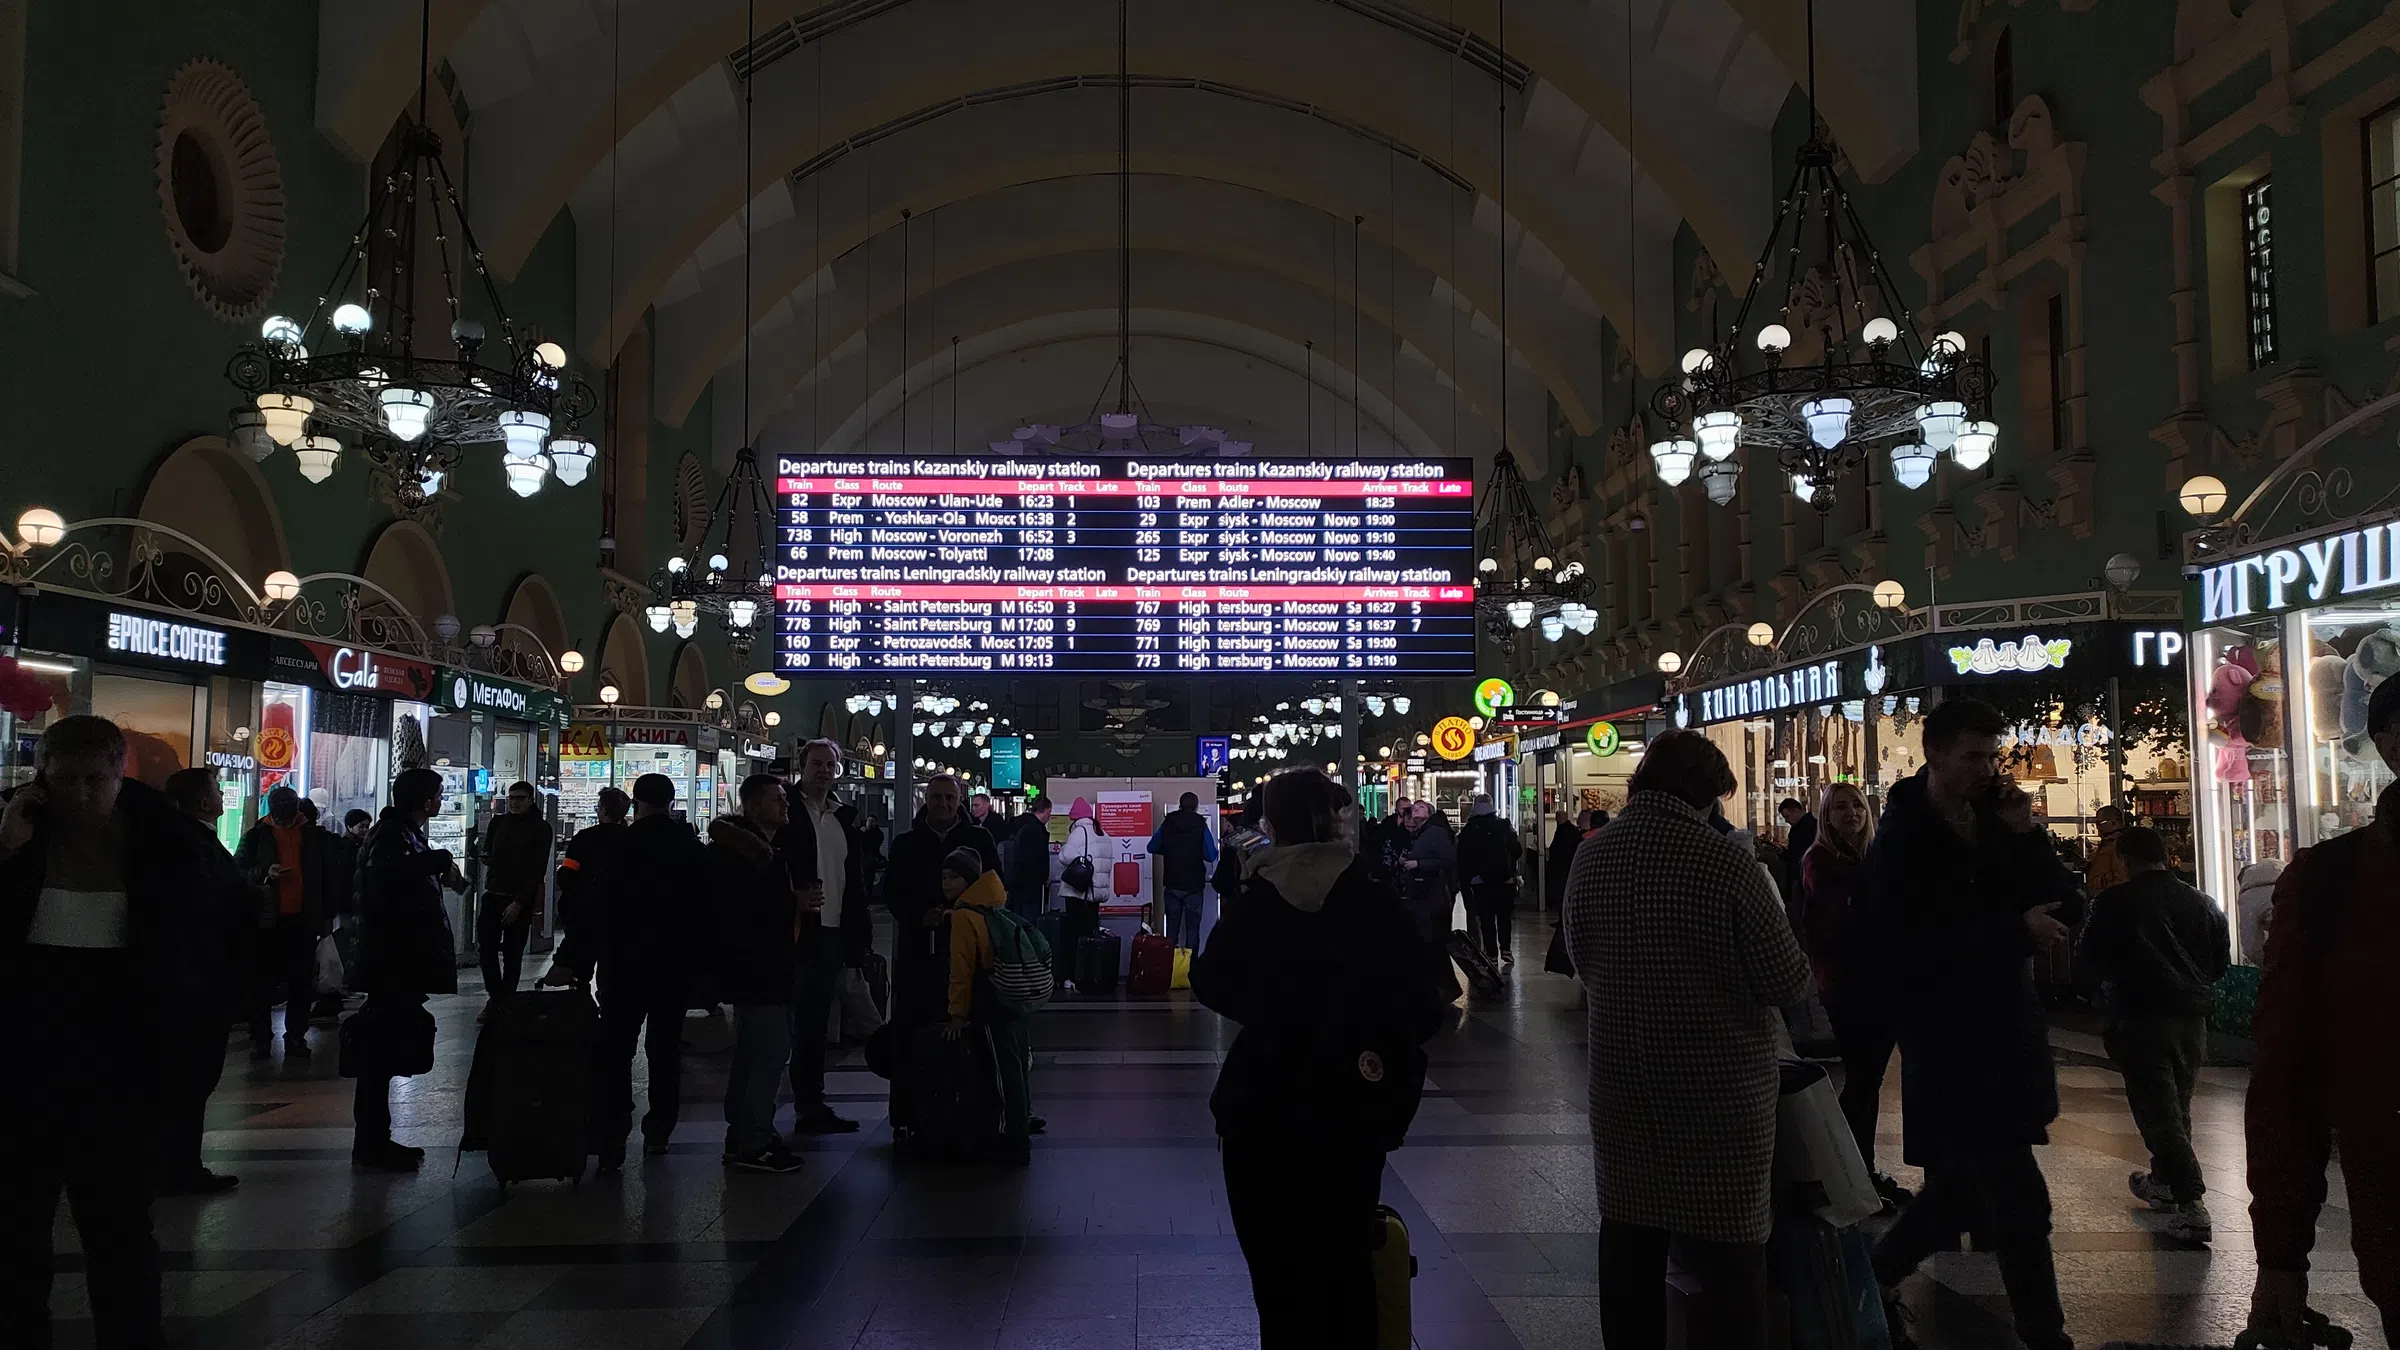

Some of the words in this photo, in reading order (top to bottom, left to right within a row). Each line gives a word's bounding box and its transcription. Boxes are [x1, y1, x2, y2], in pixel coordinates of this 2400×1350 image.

[779, 459, 866, 478] Departures
[866, 460, 911, 475] trains
[913, 460, 990, 478] Kazanskiy
[991, 460, 1046, 479] railway
[1047, 461, 1101, 476] station
[1127, 462, 1212, 480] Departures
[1212, 462, 1257, 477] trains
[1258, 462, 1334, 480] Kazanskiy
[1334, 461, 1390, 480] railway
[1390, 463, 1444, 477] station
[786, 478, 813, 489] Train
[833, 478, 860, 489] Class
[872, 478, 903, 490] Route
[1018, 480, 1055, 493] Depart
[1057, 480, 1086, 491] Track
[1095, 481, 1119, 492] Late
[1135, 481, 1161, 491] Train
[1181, 481, 1207, 492] Class
[1218, 481, 1249, 492] Route
[1362, 482, 1398, 492] Arrives
[1401, 481, 1429, 492] Track
[1439, 482, 1462, 492] Late
[791, 493, 809, 506] 82
[831, 494, 863, 509] Expr
[871, 494, 928, 507] Moscow
[939, 494, 1004, 507] Ulan-Ude
[1018, 493, 1054, 508] 16:23
[1068, 494, 1075, 508] 1
[1136, 496, 1161, 508] 103
[1176, 496, 1212, 508] Prem
[1217, 495, 1256, 508] Adler
[1265, 496, 1322, 509] Moscow
[1365, 497, 1395, 508] 18:25
[791, 511, 809, 524] 58
[829, 511, 864, 524] Prem
[884, 510, 969, 525] Yoshkar-Ola
[1018, 513, 1055, 525] 16:38
[1066, 510, 1078, 526] 2
[1139, 513, 1157, 526] 29
[1179, 513, 1210, 528] Expr
[1217, 512, 1250, 528] siysk
[1260, 514, 1316, 526] Moscow
[1323, 514, 1361, 527] Novo
[1365, 515, 1396, 525] 19:00
[786, 529, 813, 541] 738
[830, 528, 863, 544] High
[871, 529, 928, 542] Moscow
[937, 528, 1003, 543] Voronezh
[1018, 528, 1056, 543] 16:52
[1064, 527, 1076, 543] 3
[1135, 531, 1161, 544] 265
[1179, 531, 1210, 546] Expr
[1218, 530, 1250, 546] siysk
[1260, 531, 1316, 544] Moscow
[1323, 531, 1361, 544] Novo
[1366, 532, 1396, 543] 19:10
[790, 547, 808, 560] 66
[828, 547, 864, 560] Prem
[871, 547, 928, 560] Moscow
[937, 546, 988, 562] Tolyatti
[1017, 546, 1055, 561] 17:08
[1136, 549, 1161, 561] 125
[1179, 549, 1210, 564] Expr
[1218, 548, 1251, 564] siysk
[1260, 549, 1316, 561] Moscow
[1323, 549, 1361, 561] Novo
[1365, 550, 1396, 561] 19:40
[777, 566, 858, 582] Departures
[859, 566, 901, 580] trains
[903, 566, 1002, 583] Leningradskiy
[1003, 566, 1055, 583] railway
[1056, 567, 1107, 581] station
[1127, 568, 1207, 584] Departures
[1207, 567, 1249, 581] trains
[1250, 567, 1348, 584] Leningradskiy
[1348, 567, 1400, 584] railway
[1400, 568, 1451, 582] station
[785, 585, 812, 596] Train
[832, 585, 859, 596] Class
[870, 585, 902, 596] Route
[1017, 586, 1054, 599] Depart
[1057, 586, 1085, 597] Track
[1095, 587, 1118, 597] Late
[1134, 586, 1161, 597] Train
[1181, 586, 1207, 597] Class
[1218, 587, 1250, 597] Route
[1363, 587, 1399, 597] Arrives
[1402, 586, 1431, 597] Track
[1439, 587, 1464, 598] Late
[785, 600, 812, 612] 776
[829, 599, 862, 615] High
[883, 600, 919, 613] Saint
[920, 599, 993, 616] Petersburg
[1017, 601, 1054, 613] 16:50
[1066, 600, 1076, 613] 3
[1135, 601, 1161, 614] 767
[1178, 601, 1211, 616] High
[1217, 601, 1273, 616] tersburg
[1282, 601, 1339, 614] Moscow
[1366, 602, 1396, 613] 16:27
[1411, 600, 1422, 614] 5
[784, 618, 811, 630] 778
[828, 617, 862, 634] High
[883, 617, 919, 631] Saint
[919, 617, 992, 634] Petersburg
[1017, 617, 1054, 631] 17:00
[1066, 618, 1076, 631] 9
[1135, 619, 1161, 632] 769
[1178, 618, 1211, 634] High
[1217, 618, 1273, 634] tersburg
[1283, 619, 1340, 632] Moscow
[1366, 620, 1397, 631] 16:37
[1411, 618, 1422, 632] 7
[108, 612, 121, 650] ONE
[119, 613, 171, 657] PRICE
[169, 623, 229, 667] COFFEE
[785, 636, 811, 648] 160
[829, 636, 861, 651] Expr
[883, 636, 973, 649] Petrozavodsk
[1017, 636, 1054, 649] 17:05
[1067, 636, 1075, 649] 1
[1135, 637, 1159, 649] 771
[1178, 636, 1211, 652] High
[1217, 636, 1273, 652] tersburg
[1283, 636, 1340, 649] Moscow
[1366, 638, 1397, 648] 19:00
[274, 656, 319, 671] АКСЕССУАРЫ
[784, 653, 811, 666] 780
[828, 653, 861, 669] High
[882, 654, 918, 666] Saint
[919, 653, 992, 669] Petersburg
[1017, 654, 1054, 667] 19:13
[1135, 654, 1161, 667] 773
[1178, 654, 1211, 670] High
[1217, 654, 1273, 670] tersburg
[1283, 654, 1340, 667] Moscow
[1366, 655, 1398, 666] 19:10
[1701, 660, 1839, 722] ХИНКАЛЬНАЯ
[1438, 718, 1472, 735] ПАТИО
[625, 727, 689, 744] КНИГА
